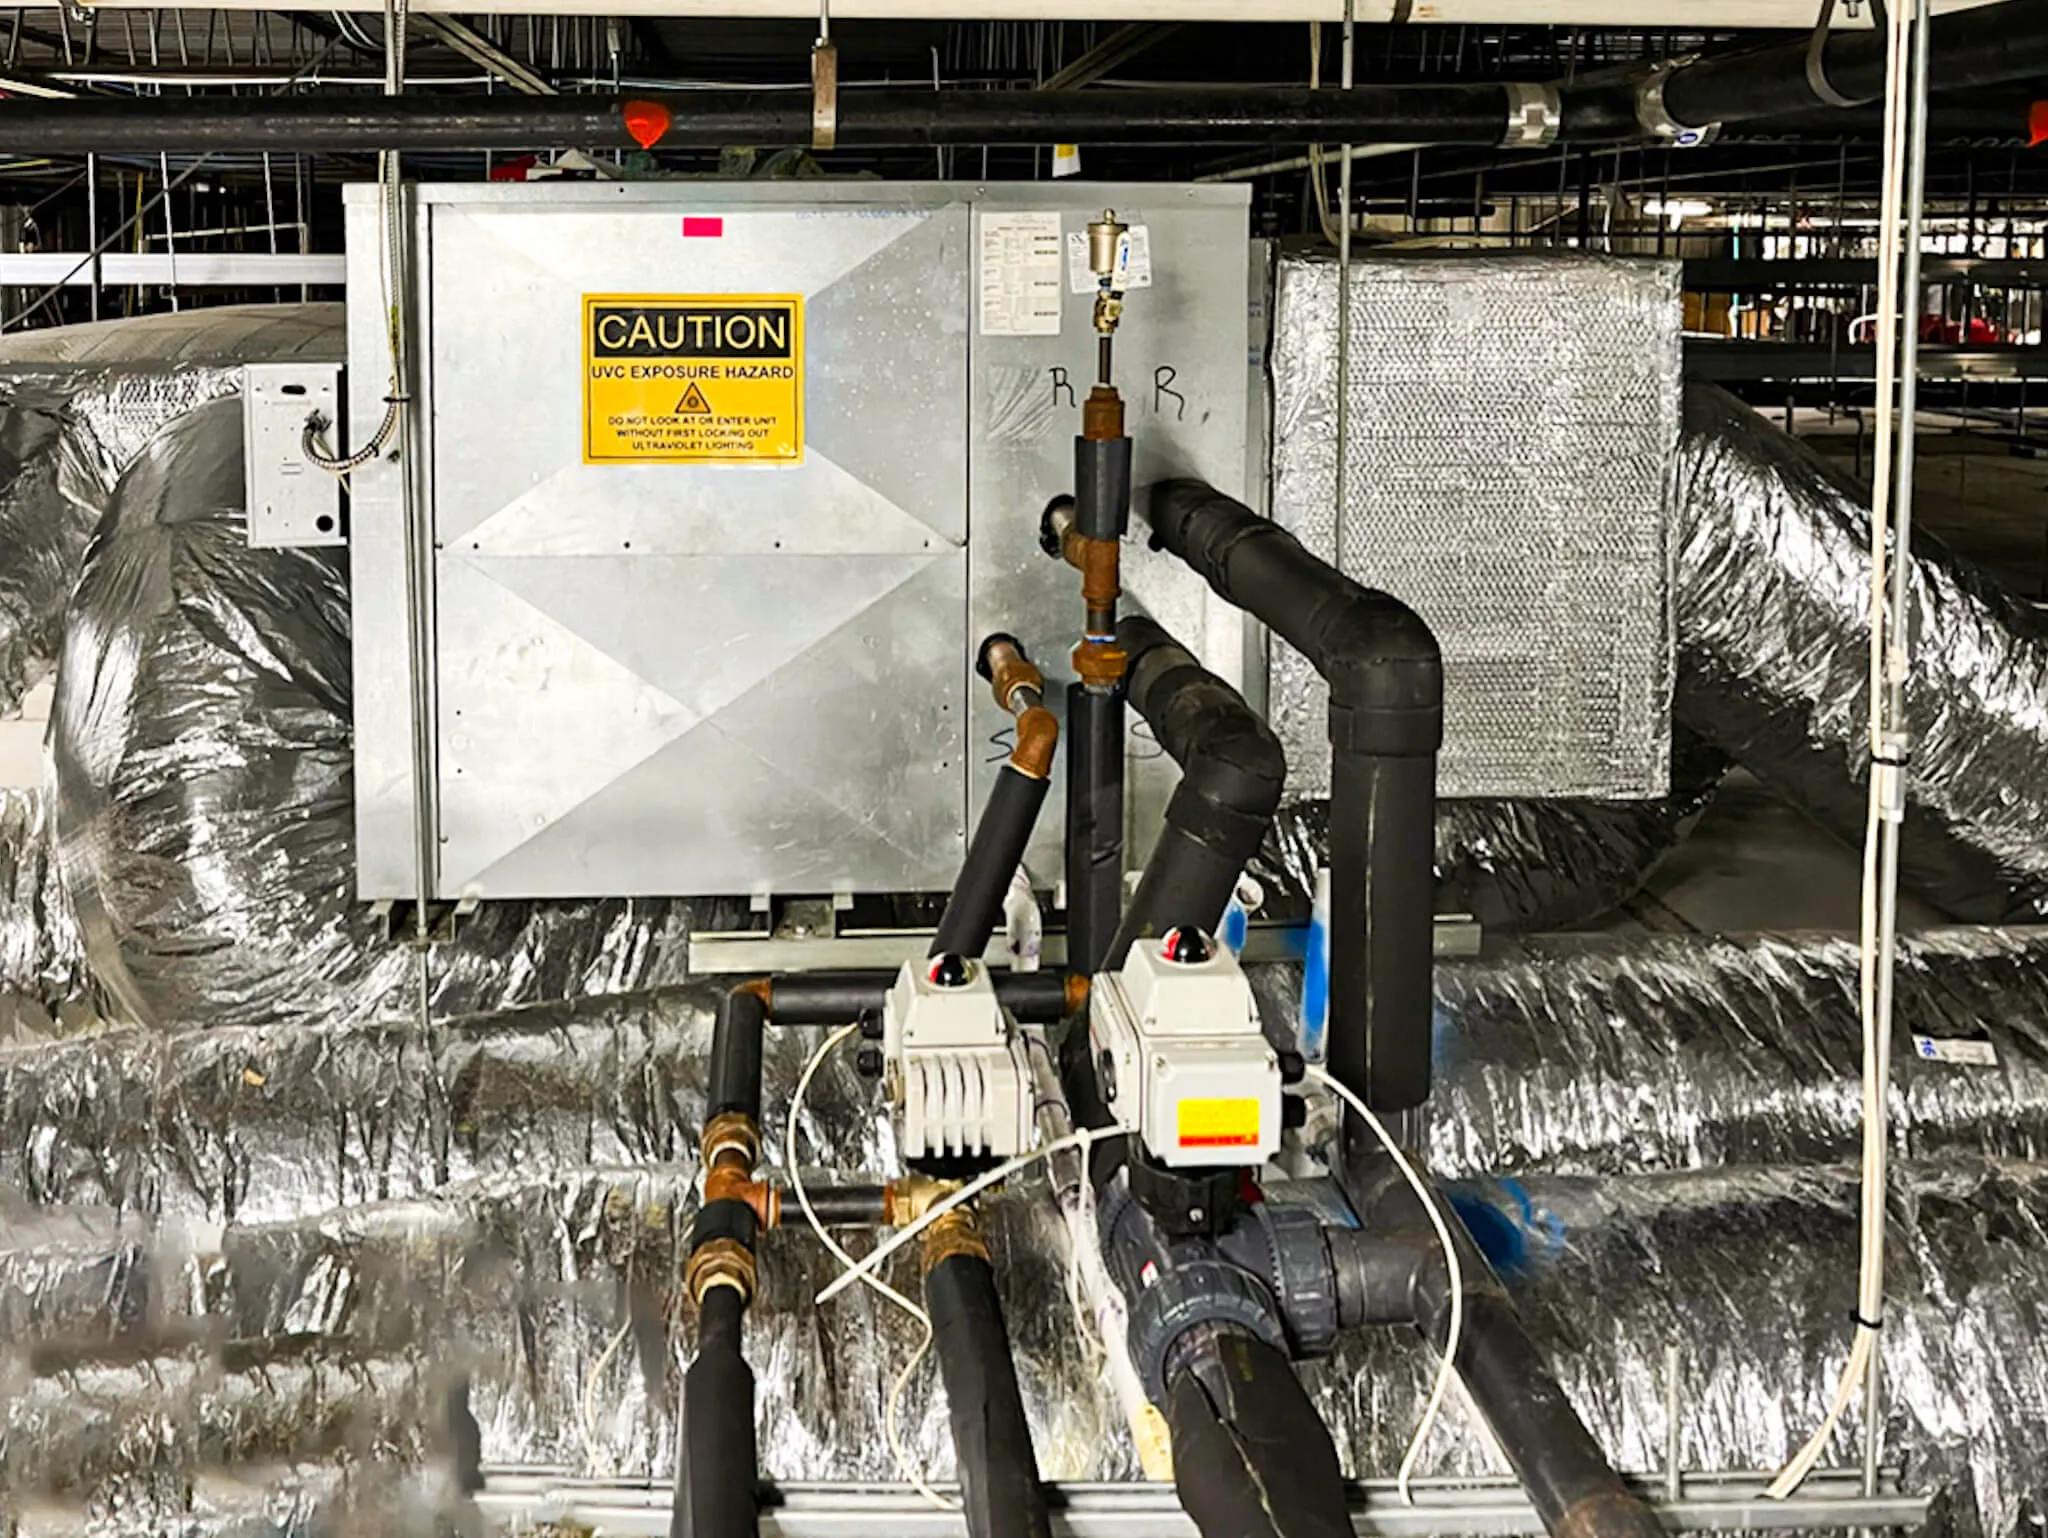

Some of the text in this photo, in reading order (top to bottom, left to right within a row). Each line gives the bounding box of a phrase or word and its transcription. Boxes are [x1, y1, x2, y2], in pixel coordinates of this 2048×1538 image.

[598, 314, 785, 350] CAUTION
[591, 365, 794, 379] UVC EXPOSURE HAZARD
[1048, 367, 1077, 408] R
[1154, 365, 1185, 421] R
[608, 416, 777, 425] DO NOT LOOK AT OR ENTER UNIT
[616, 429, 769, 438] WITHOUT FIRST LOCKING OUT
[632, 441, 754, 450] ULTRAVIOLET LIGHTING
